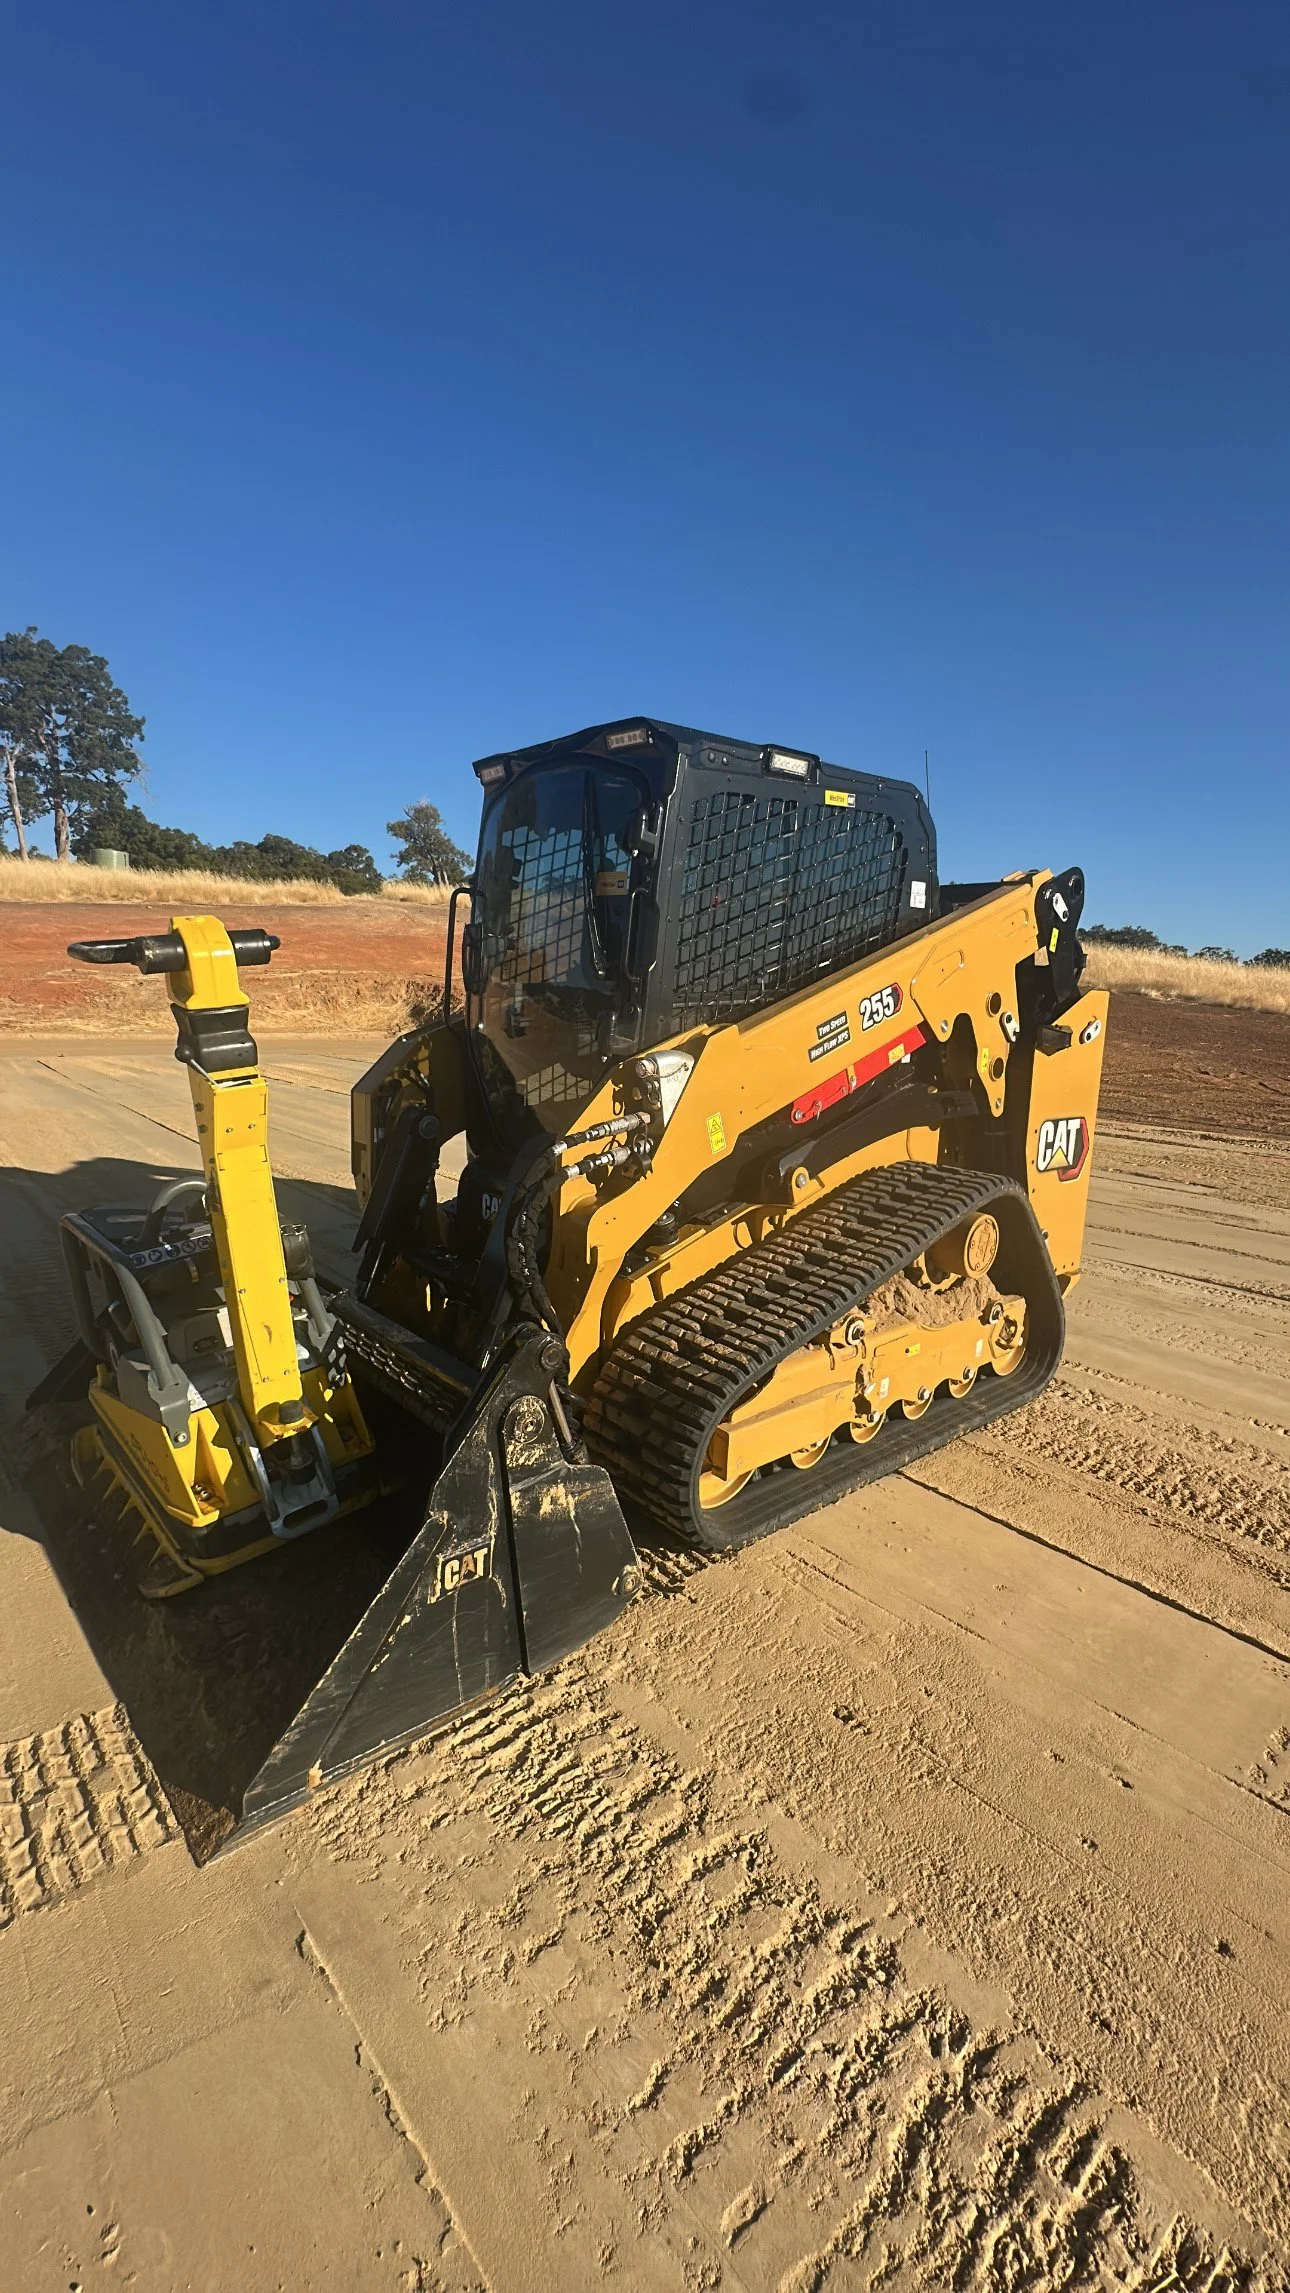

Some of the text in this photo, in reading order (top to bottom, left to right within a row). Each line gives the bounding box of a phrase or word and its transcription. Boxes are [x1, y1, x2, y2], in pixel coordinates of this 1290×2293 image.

[859, 986, 895, 1030] 255
[837, 1030, 849, 1044] XPS
[1037, 1118, 1081, 1171] CAT
[482, 1193, 502, 1220] CA
[444, 1547, 488, 1590] CAT
